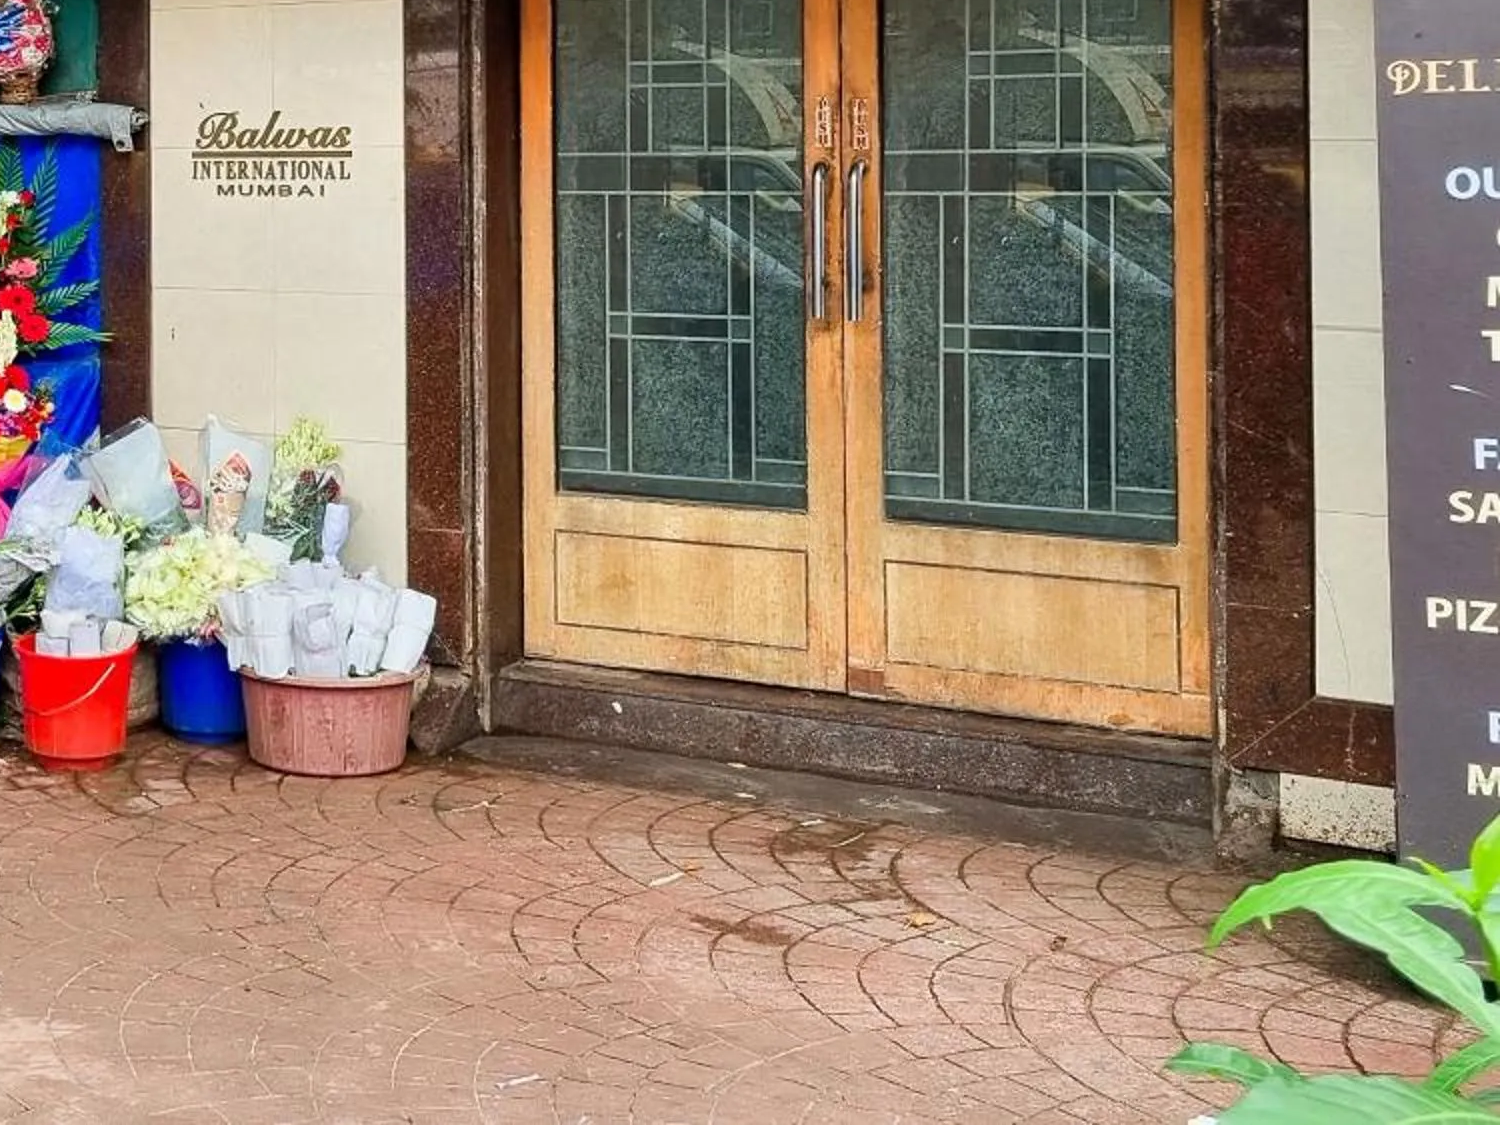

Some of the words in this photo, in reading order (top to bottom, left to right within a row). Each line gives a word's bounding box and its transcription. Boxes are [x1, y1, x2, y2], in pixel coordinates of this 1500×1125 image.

[1387, 58, 1500, 96] DEL
[195, 110, 352, 150] Balwas
[192, 160, 351, 180] INTERNATIONAL
[216, 184, 326, 197] MUMBAI
